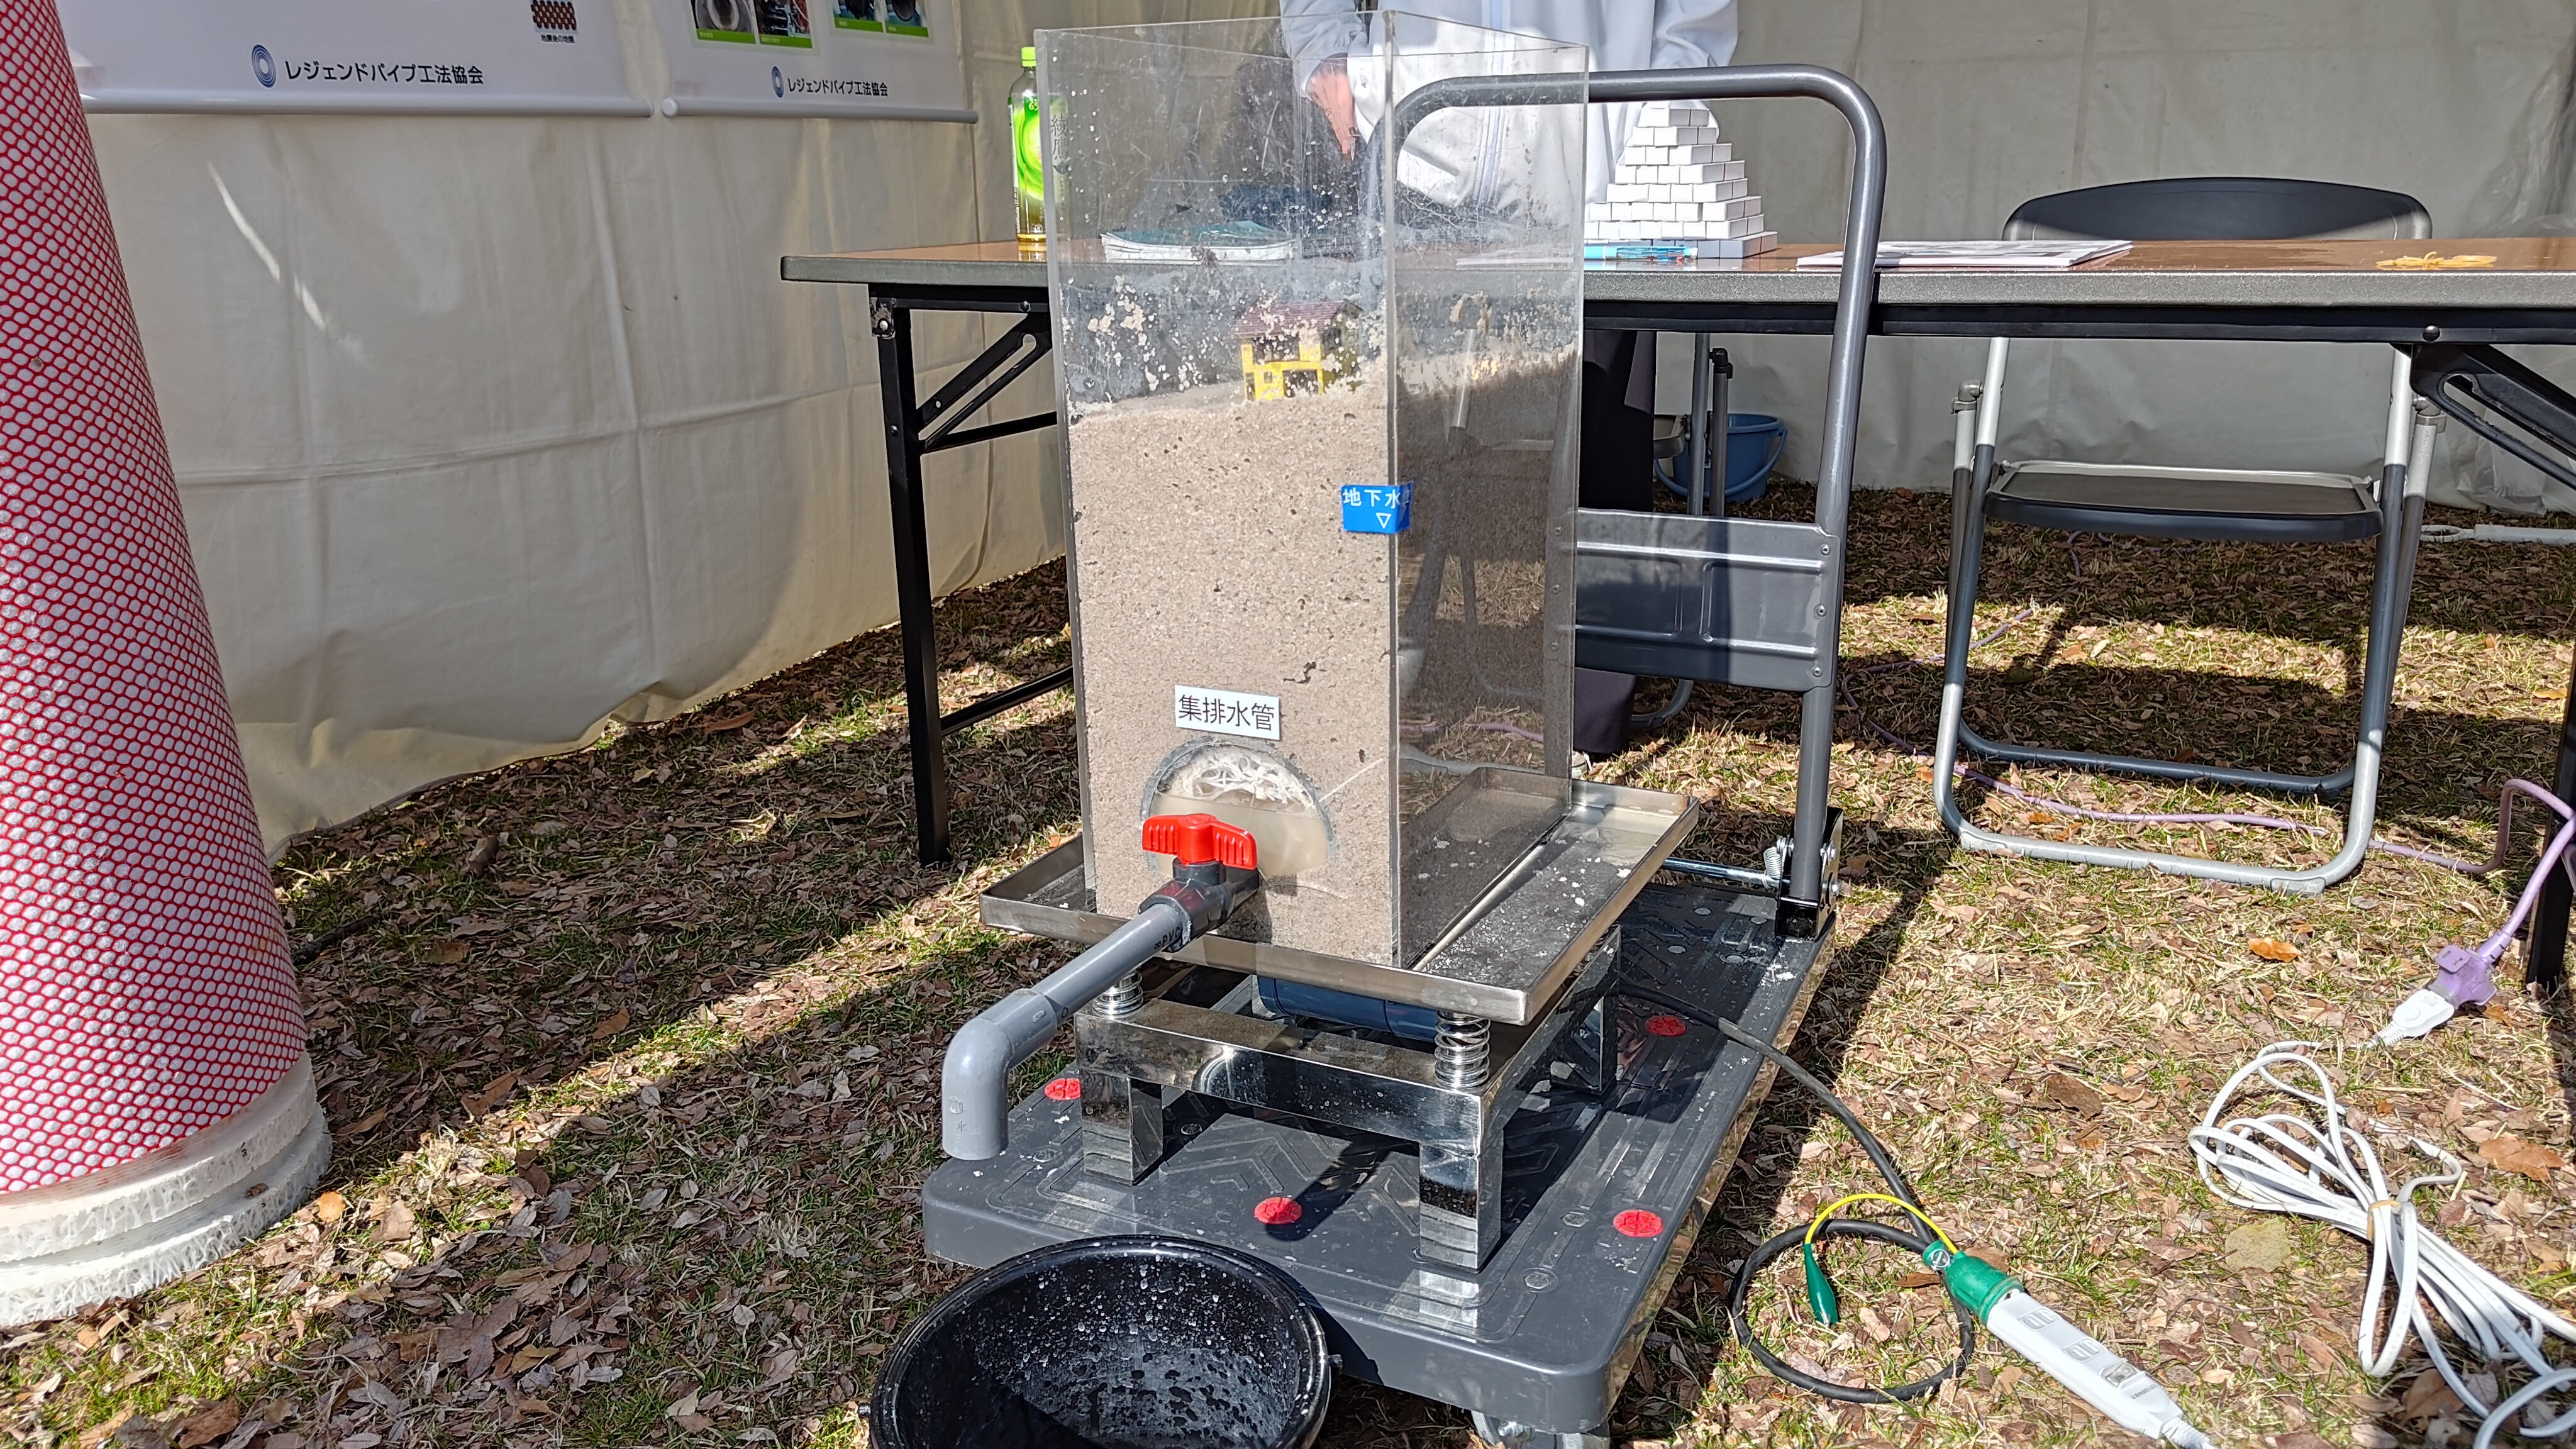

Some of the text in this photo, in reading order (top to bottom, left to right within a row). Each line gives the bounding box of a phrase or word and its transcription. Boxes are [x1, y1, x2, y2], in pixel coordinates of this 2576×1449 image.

[285, 60, 484, 84] レジェンドパイプ工法協会
[787, 78, 888, 96] レジェンドパイプ工法協会
[1179, 694, 1274, 731] 集排水管
